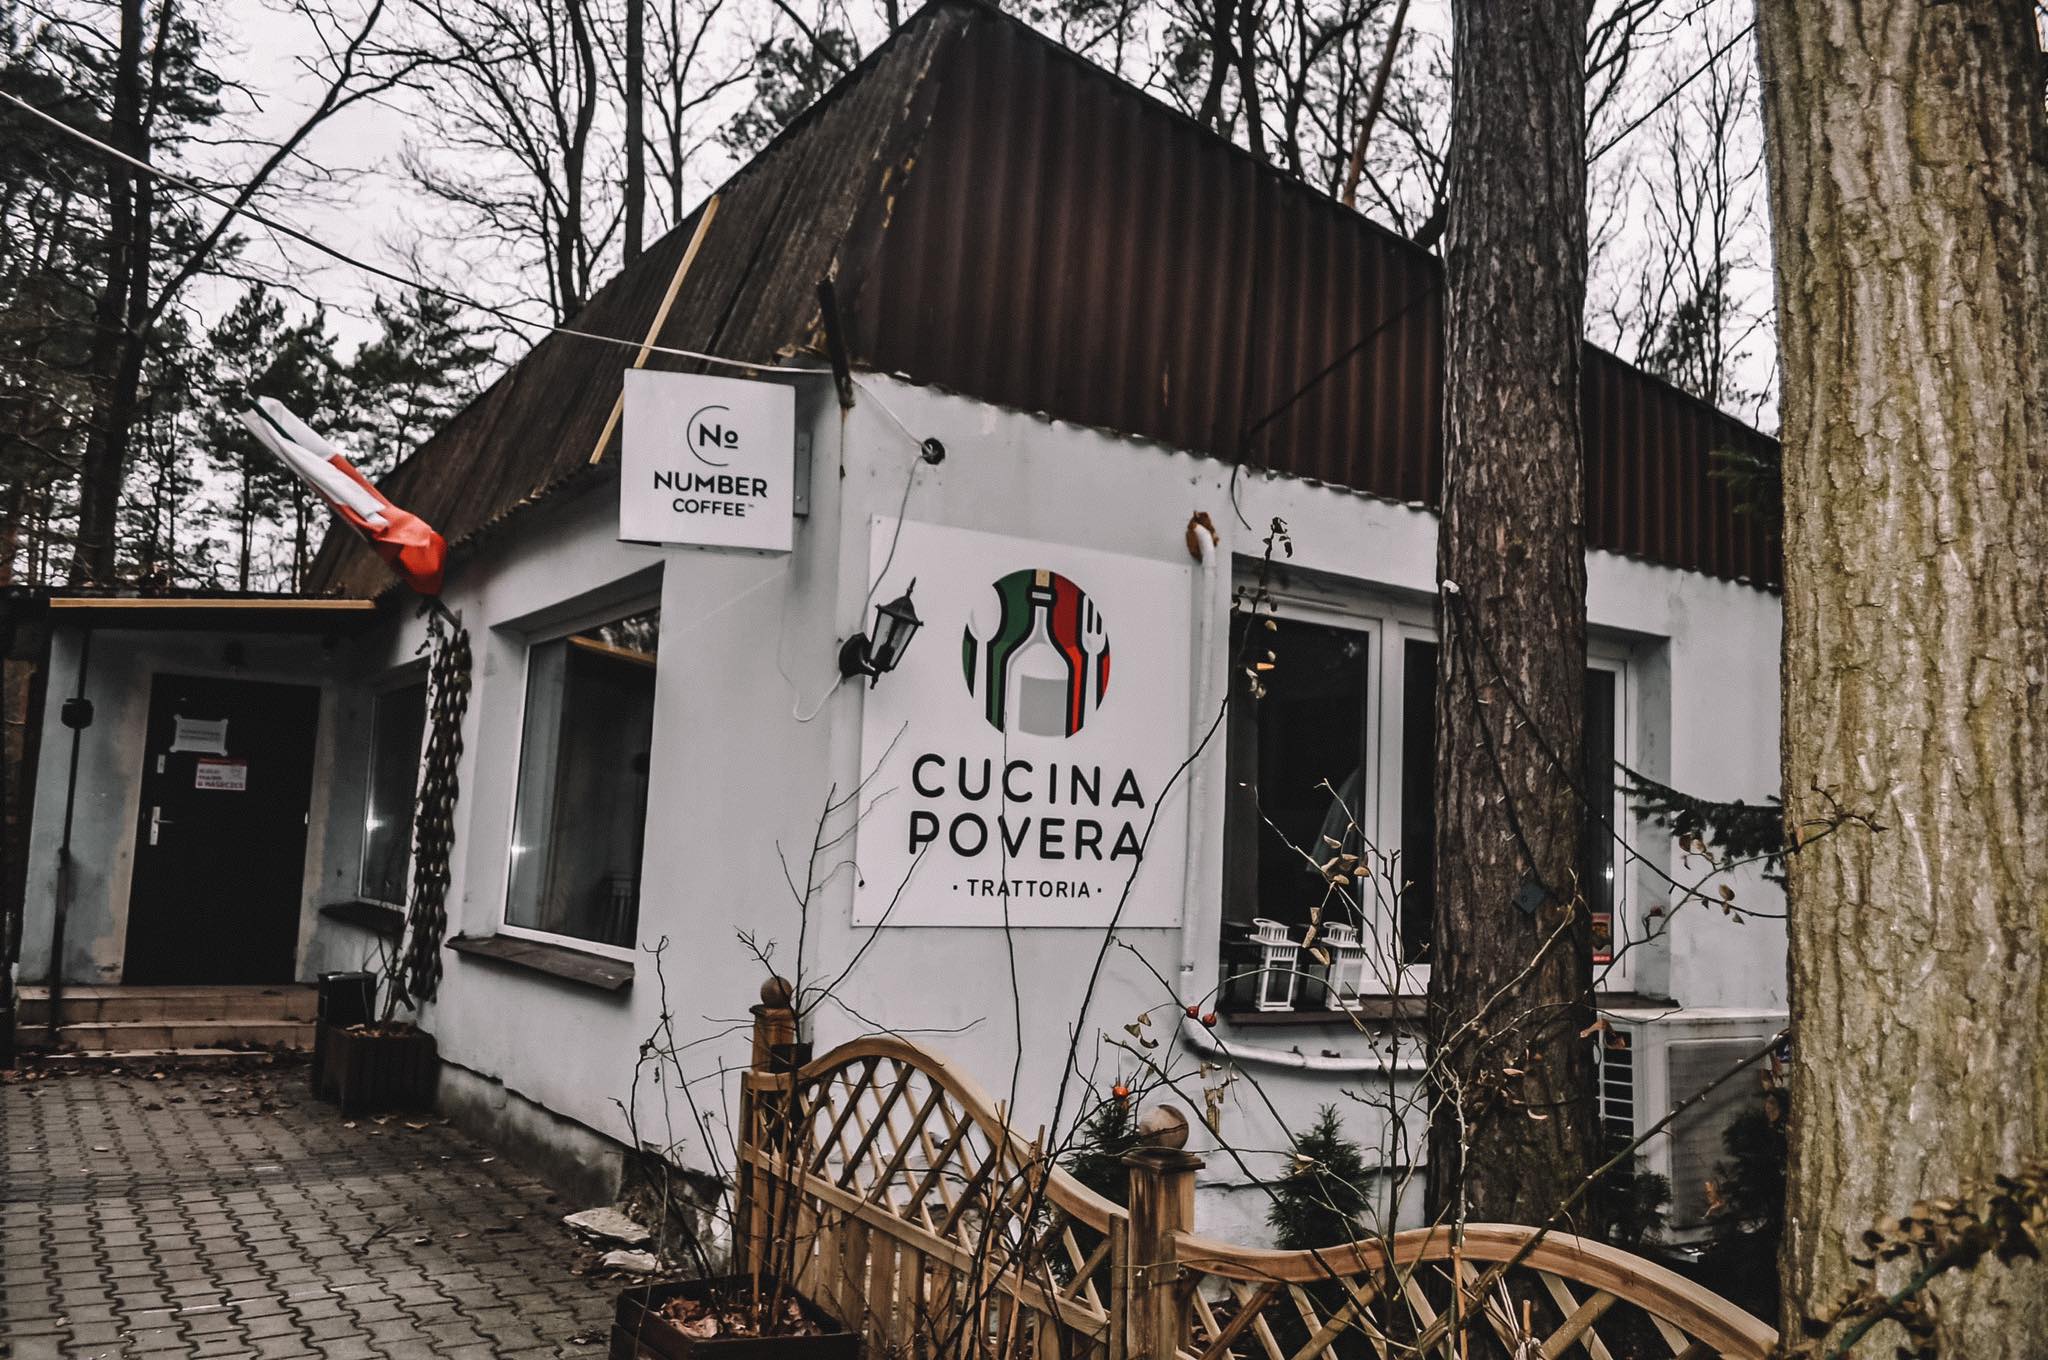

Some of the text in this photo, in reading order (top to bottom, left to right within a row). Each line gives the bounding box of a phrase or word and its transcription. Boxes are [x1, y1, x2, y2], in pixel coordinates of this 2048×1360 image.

[654, 470, 768, 498] NUMBER
[912, 753, 1145, 809] CUCINA
[908, 810, 1143, 863] POVERA
